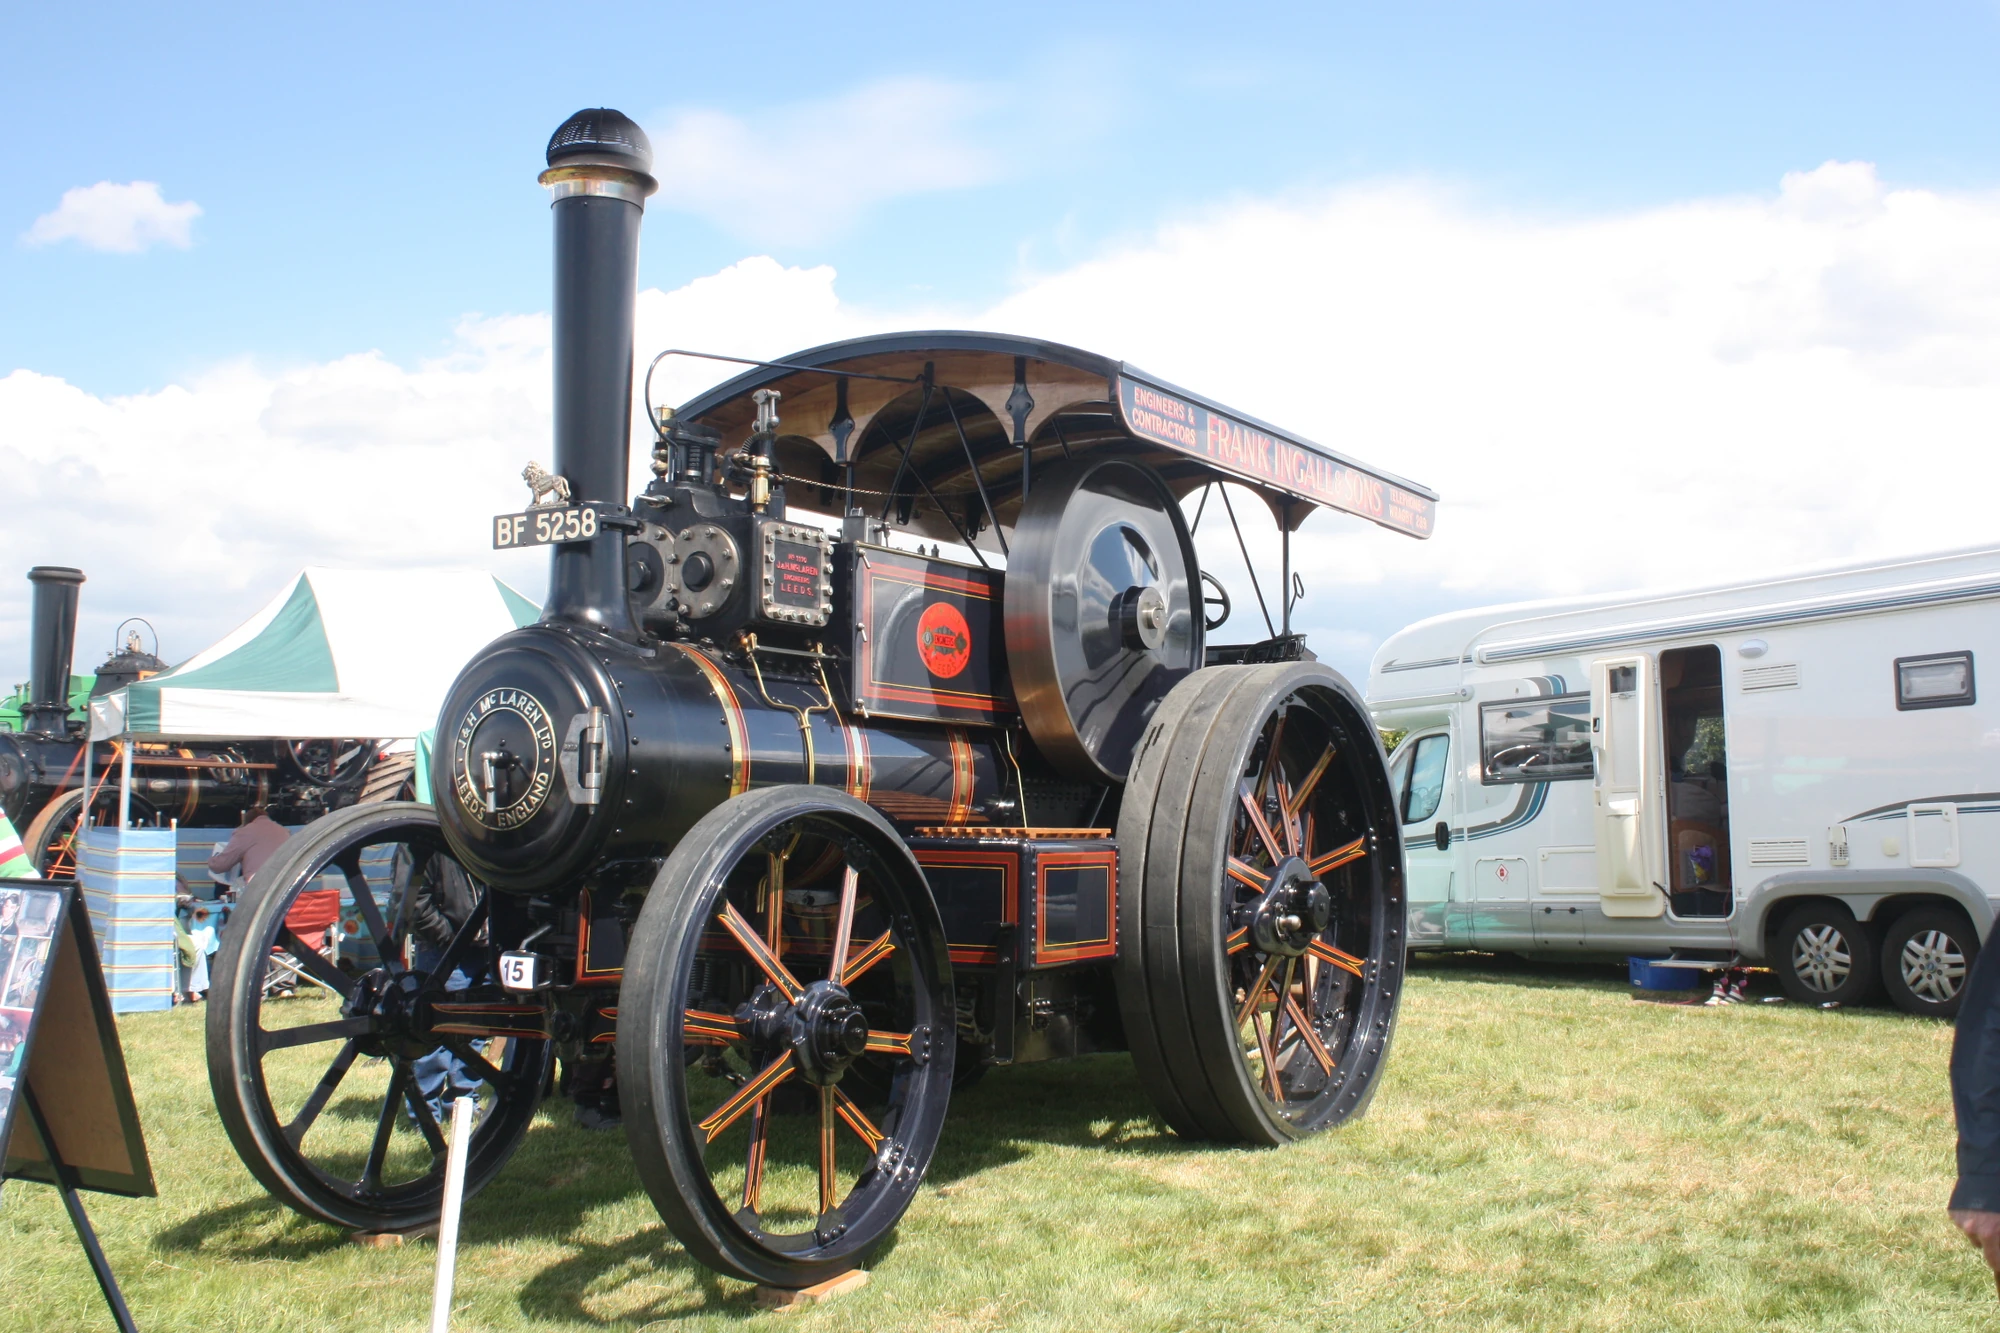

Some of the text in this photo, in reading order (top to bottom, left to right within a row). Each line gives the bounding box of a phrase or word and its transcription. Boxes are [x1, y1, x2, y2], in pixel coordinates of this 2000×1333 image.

[1134, 386, 1196, 426] ENGINEERS &
[1132, 407, 1197, 447] CONTRACTORS
[1207, 412, 1272, 480] FRANK
[1274, 439, 1335, 498] INGALL
[1344, 468, 1384, 516] SONS
[497, 508, 596, 546] BF 5258
[457, 772, 549, 827] LEEDS ENGLAND
[504, 959, 524, 982] 15
